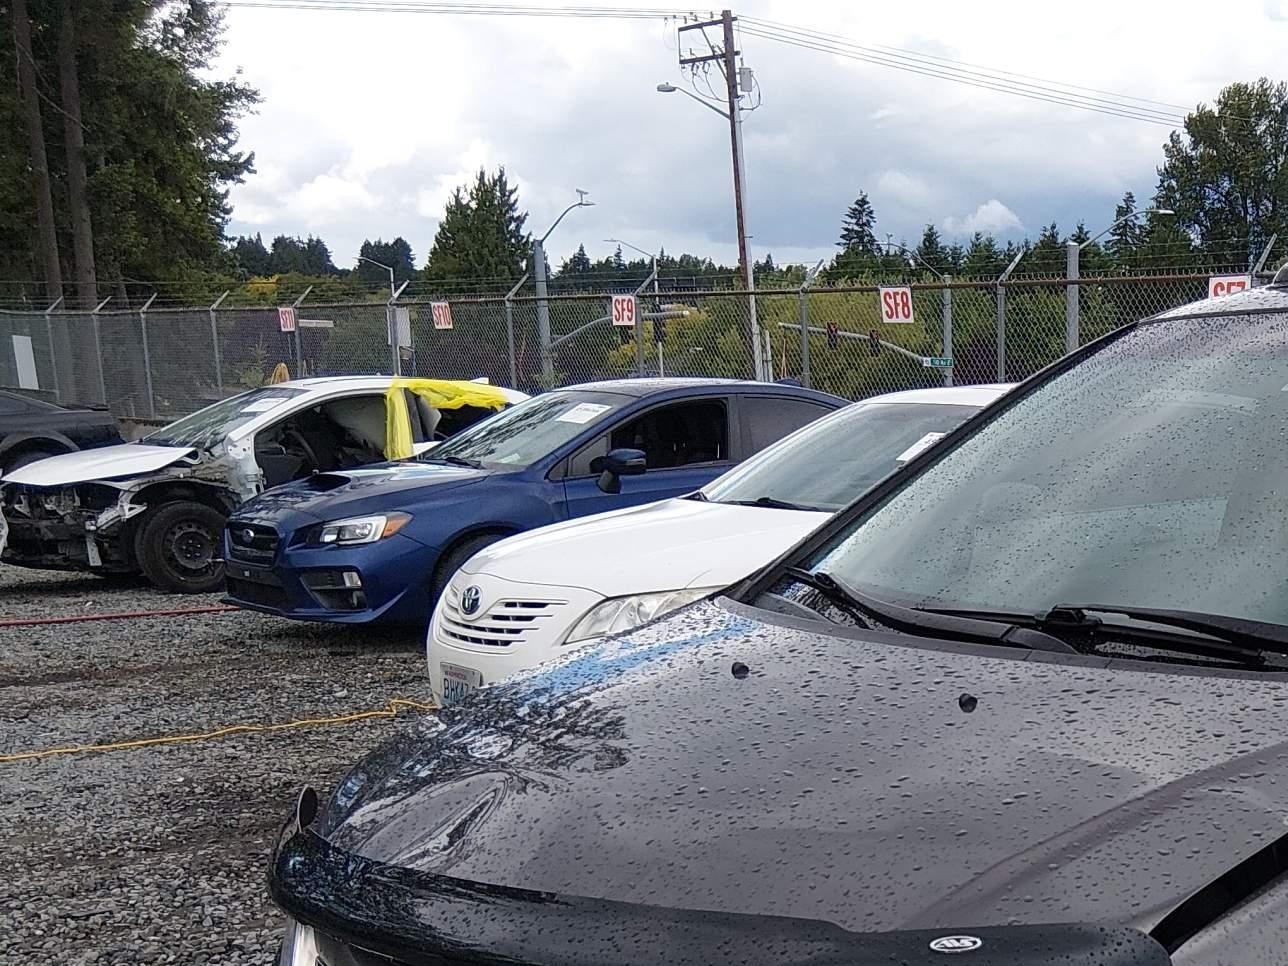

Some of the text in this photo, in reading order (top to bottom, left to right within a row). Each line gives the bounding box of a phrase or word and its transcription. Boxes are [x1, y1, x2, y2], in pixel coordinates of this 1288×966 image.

[432, 304, 451, 326] SF10
[614, 298, 634, 322] SF9
[883, 291, 911, 319] SF8
[281, 309, 295, 329] SF11
